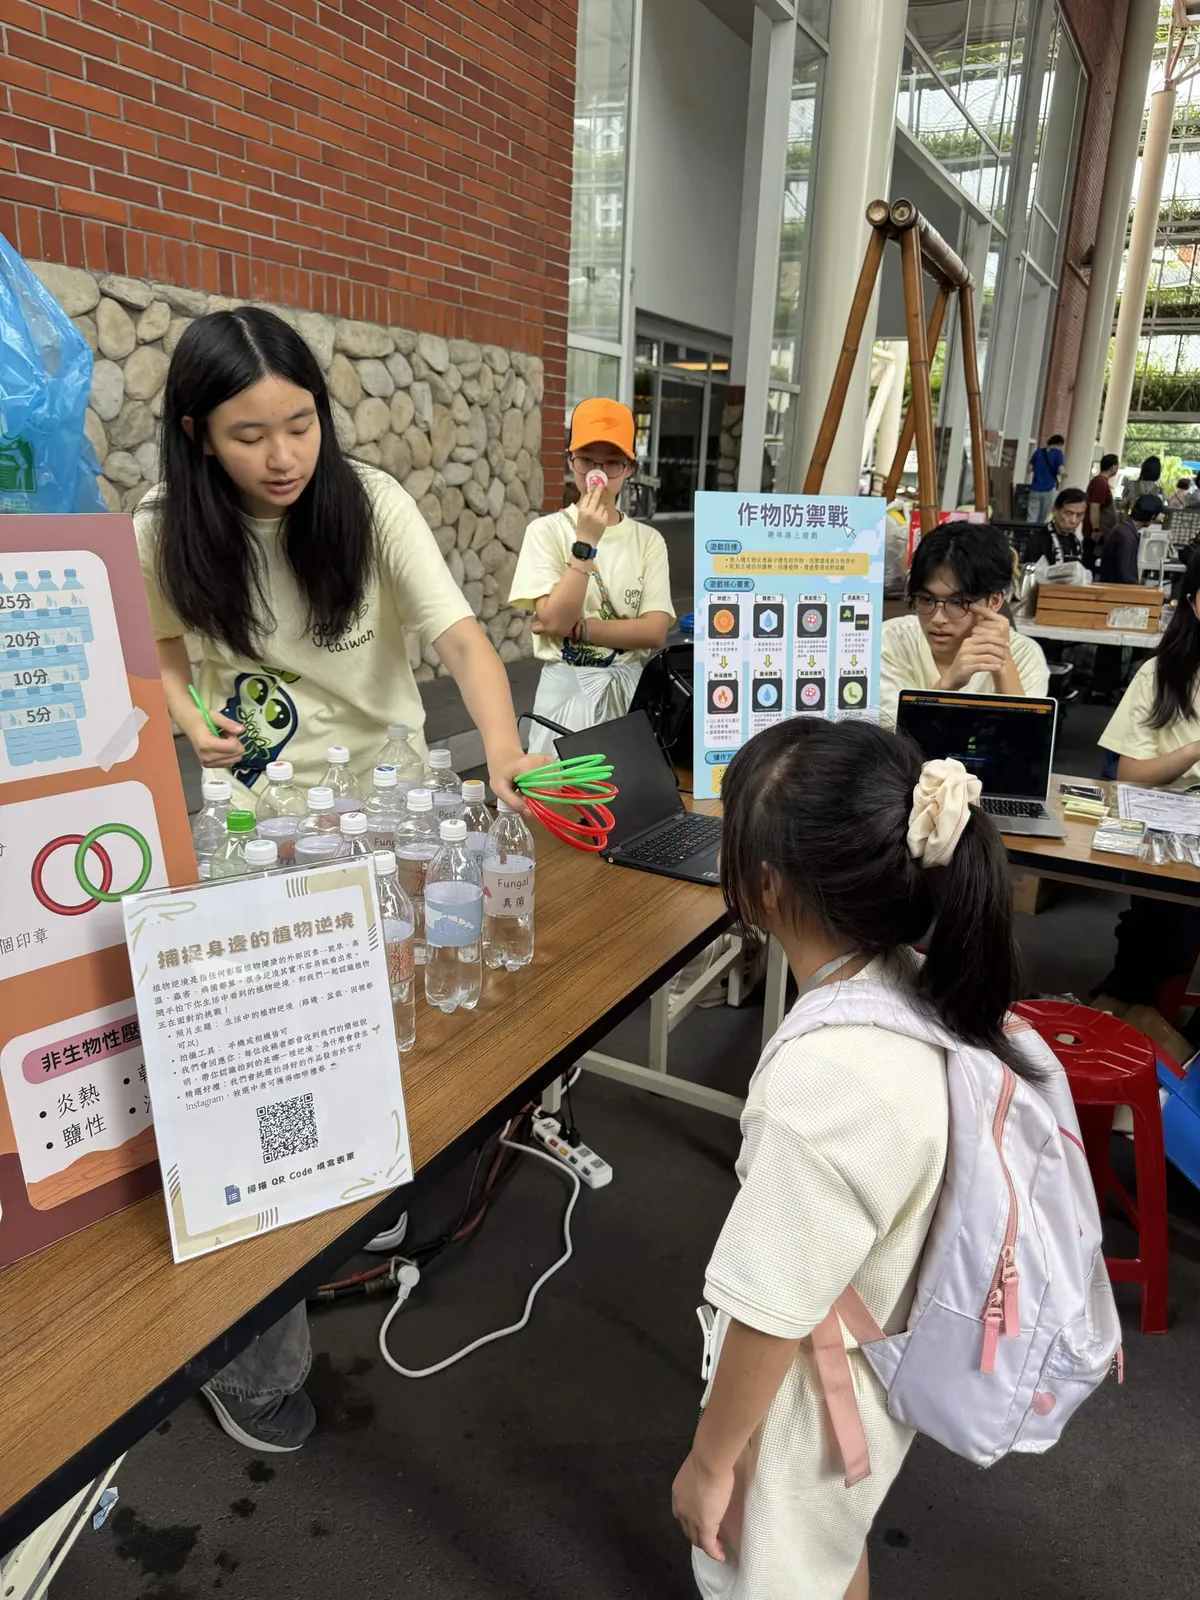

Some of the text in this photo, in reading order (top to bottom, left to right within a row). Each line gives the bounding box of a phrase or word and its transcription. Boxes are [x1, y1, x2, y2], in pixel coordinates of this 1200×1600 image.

[738, 502, 849, 528] 作物防禦戰
[710, 543, 738, 551] 遊戲目標
[710, 580, 750, 588] 遊戲核心要素
[0, 593, 31, 609] 25分
[5, 631, 40, 647] 20分
[324, 629, 374, 653] taiwan
[14, 669, 48, 686] 10分
[27, 707, 51, 723] 5分
[497, 877, 529, 890] Fungal
[502, 896, 525, 908] 真菌
[157, 912, 355, 970] 捕捉身邊的植物逆境
[41, 1020, 140, 1072] 非生物性壓
[57, 1084, 100, 1118] 炎熱
[62, 1114, 107, 1148] 鹽性
[247, 1151, 355, 1194] 掃描 QR Code 填寫表單
